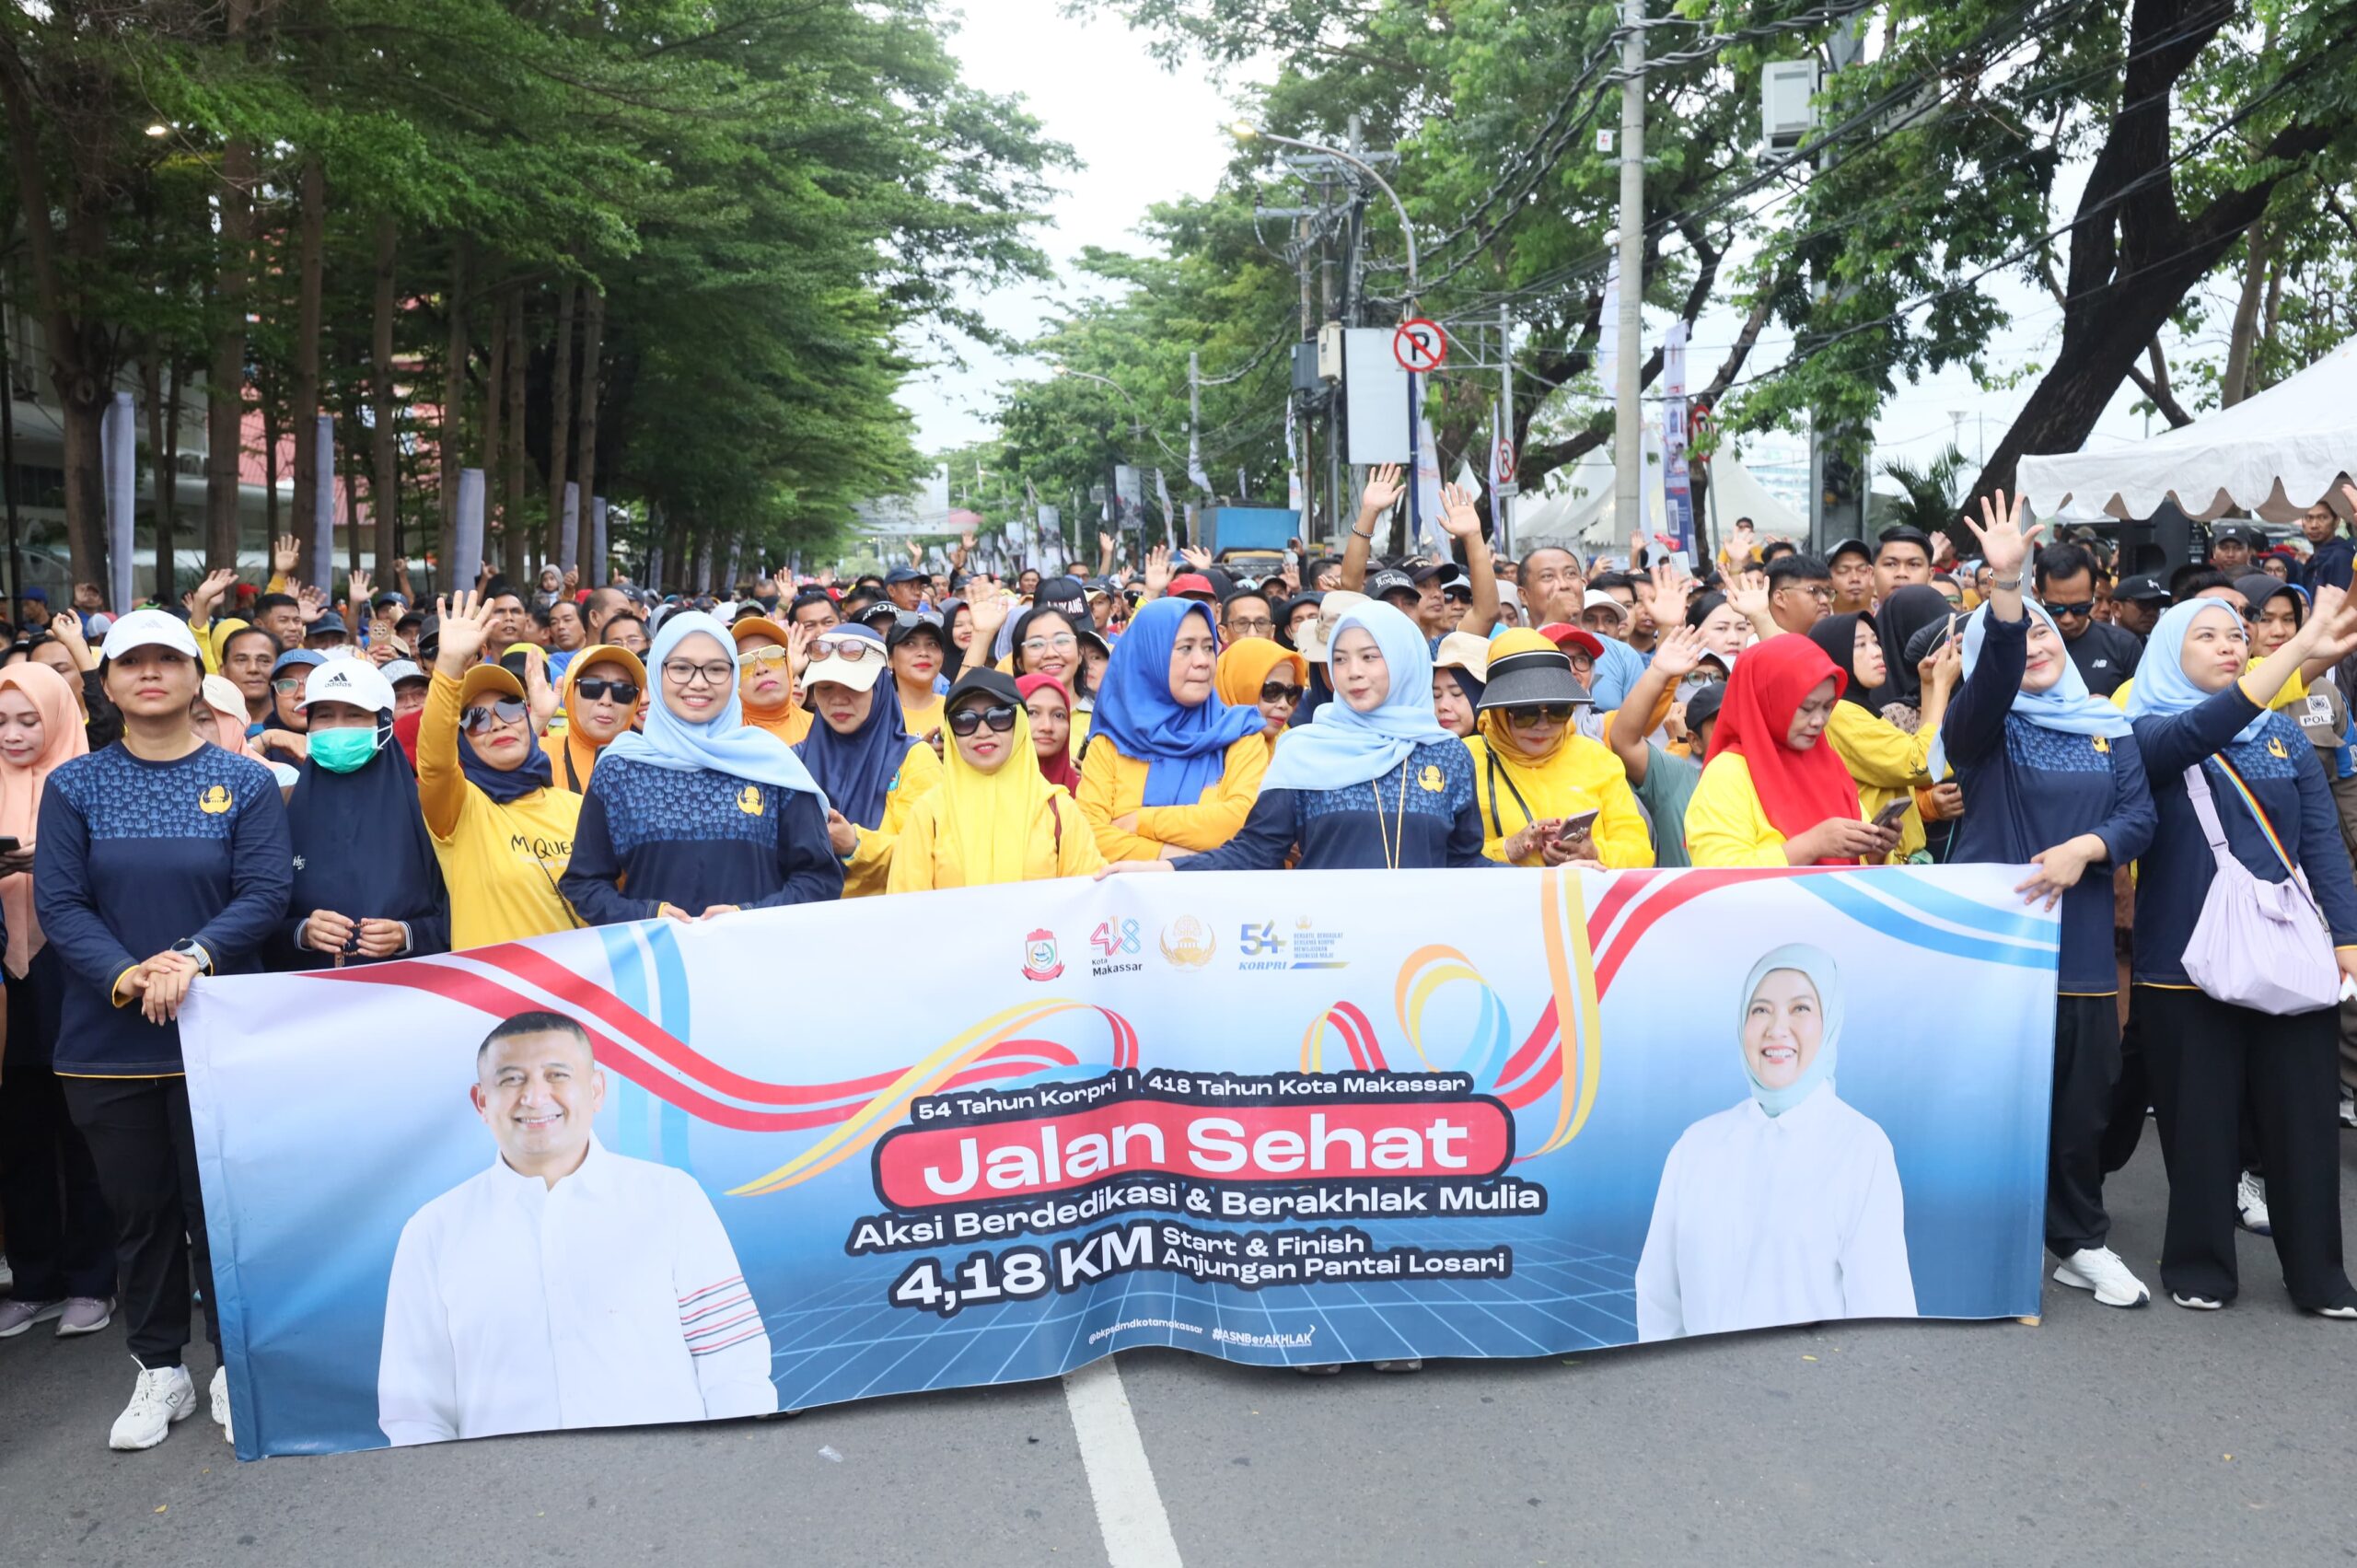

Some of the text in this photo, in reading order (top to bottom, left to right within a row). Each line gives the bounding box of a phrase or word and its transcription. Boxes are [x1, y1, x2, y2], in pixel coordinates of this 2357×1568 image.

[1240, 920, 1287, 956] 54
[1092, 958, 1108, 966] Kota
[1092, 964, 1143, 977] Makassar
[1238, 961, 1287, 970] KORPRI
[919, 1102, 951, 1120] 54
[957, 1097, 1035, 1115] Tahun
[1040, 1078, 1117, 1106] Korpri
[1148, 1075, 1191, 1094] 418
[1197, 1079, 1272, 1096] Tahun
[1279, 1077, 1337, 1095] Kota
[1343, 1076, 1466, 1094] Makassar
[923, 1112, 1468, 1196] Jalan Sehat
[853, 1182, 1540, 1249] Aksi Berdedikasi & Berakhlak Mulia
[1163, 1226, 1364, 1257] Start & Finish
[896, 1226, 1154, 1311] 4,18 KM
[1163, 1249, 1505, 1284] Anjungan Pantai Losari
[1088, 1318, 1313, 1345] @bkpsdmdkotamakassar #ASNBerAKHLAK
